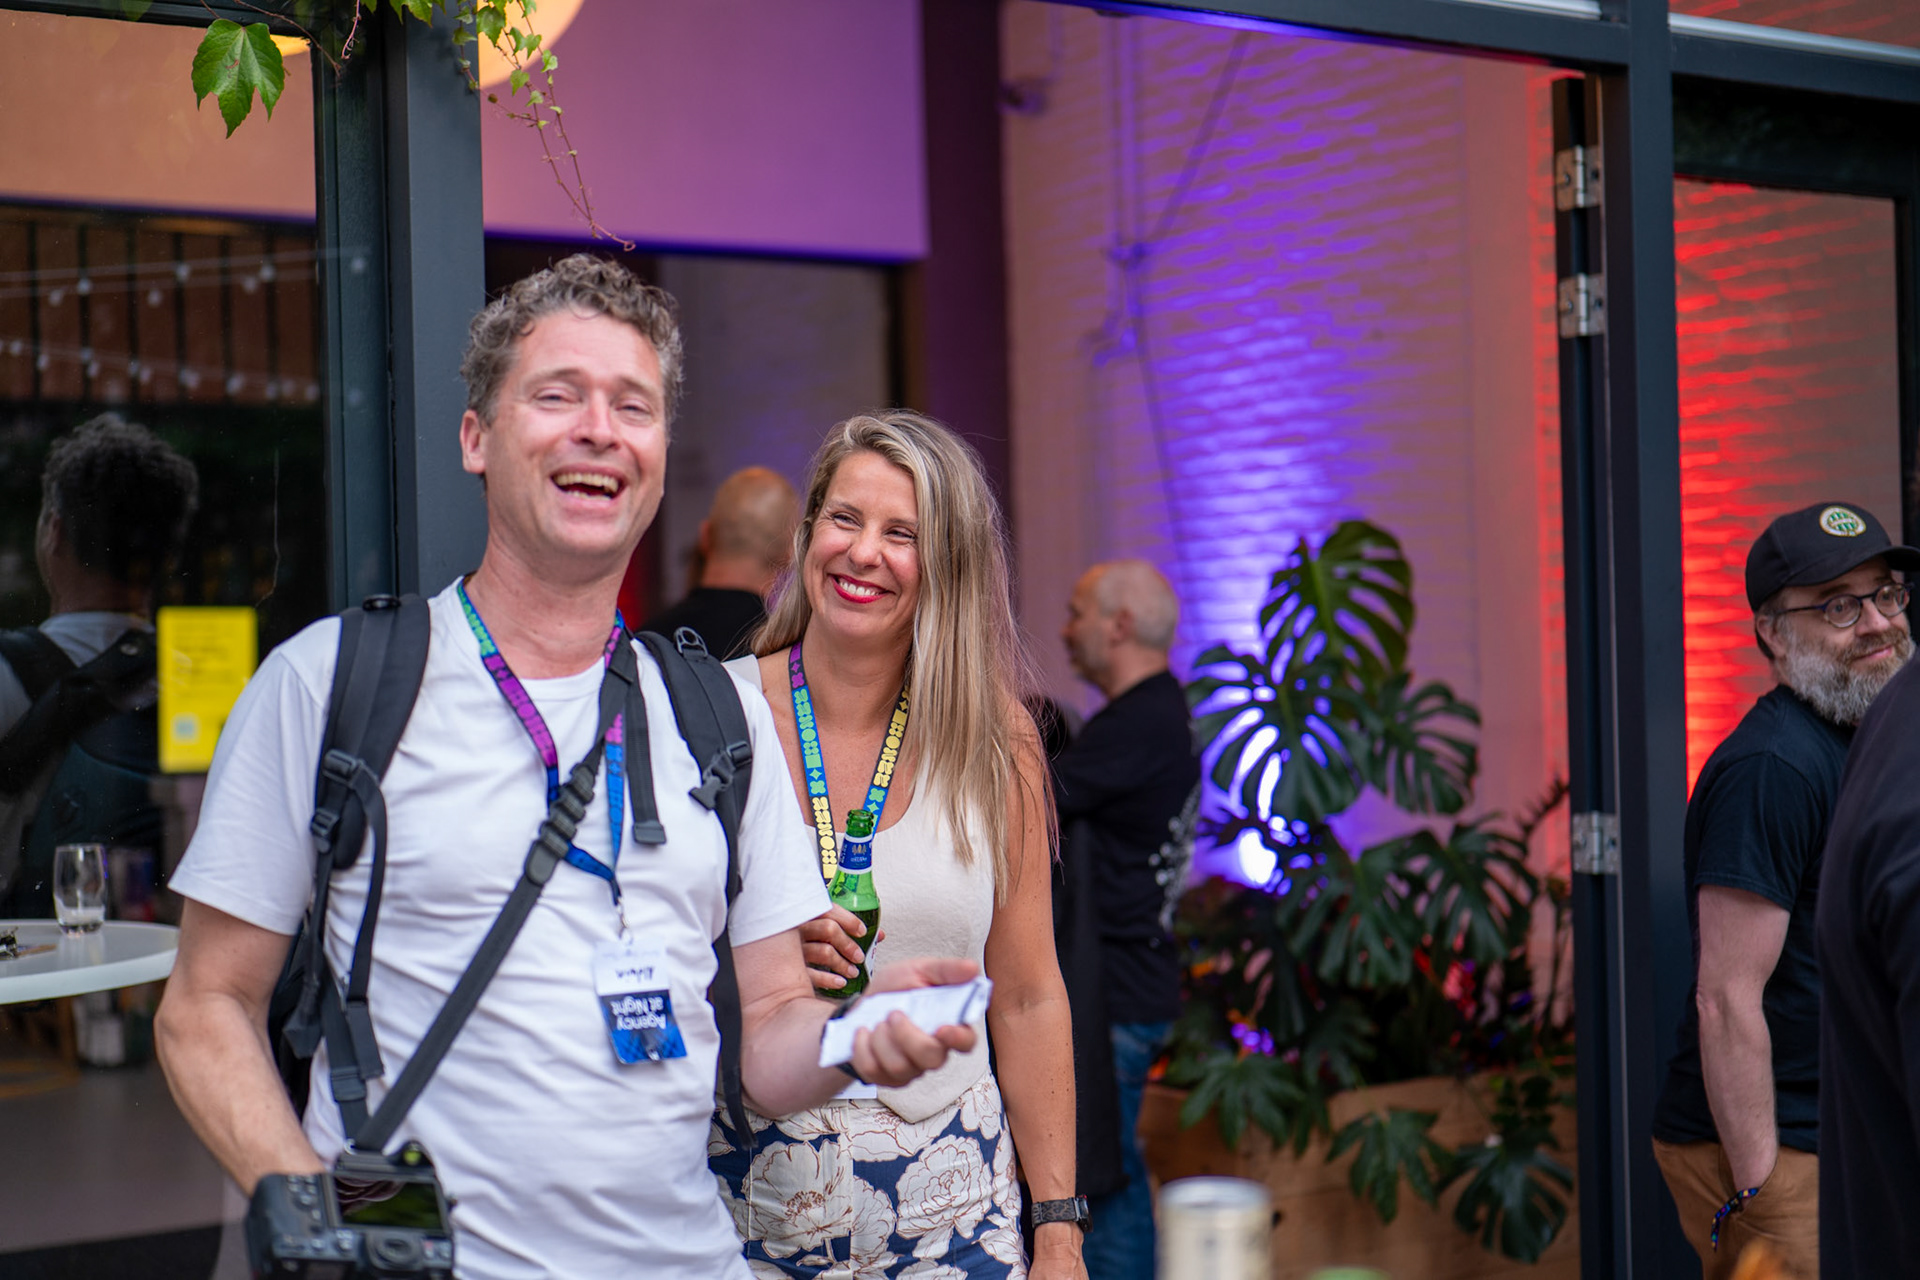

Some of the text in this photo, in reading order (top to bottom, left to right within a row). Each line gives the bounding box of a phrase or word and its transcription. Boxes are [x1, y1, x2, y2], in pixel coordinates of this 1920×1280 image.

[611, 996, 664, 1015] at Night
[616, 1013, 667, 1031] Agency
